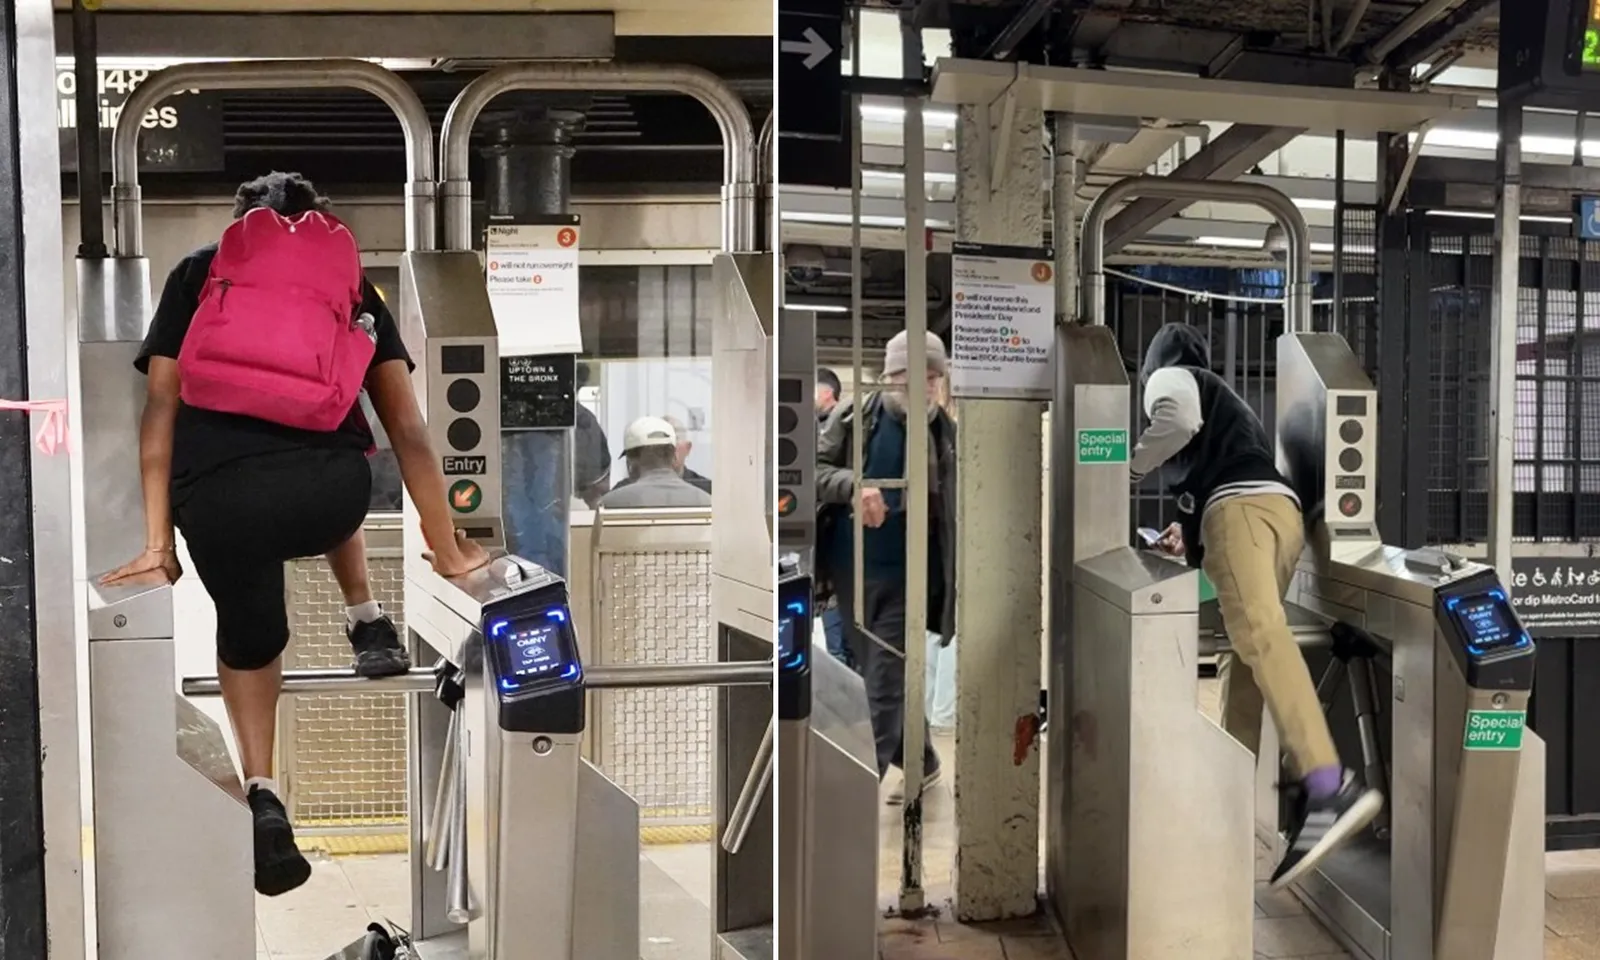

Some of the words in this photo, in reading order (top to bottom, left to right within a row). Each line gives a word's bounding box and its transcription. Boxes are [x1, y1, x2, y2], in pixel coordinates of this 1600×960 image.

[57, 99, 77, 128] ll
[498, 228, 518, 236] Night
[540, 262, 574, 270] overnight
[998, 314, 1012, 322] Day
[955, 344, 990, 353] Delancey
[508, 366, 546, 374] UPTOWN
[1080, 432, 1125, 446] Special
[1080, 446, 1112, 458] entry
[444, 458, 484, 474] Entry
[1512, 597, 1523, 606] or
[1524, 594, 1540, 607] dip
[1542, 593, 1594, 604] MetroCard
[517, 635, 547, 647] OMNY
[1470, 714, 1523, 730] Special
[1468, 730, 1506, 744] entry
